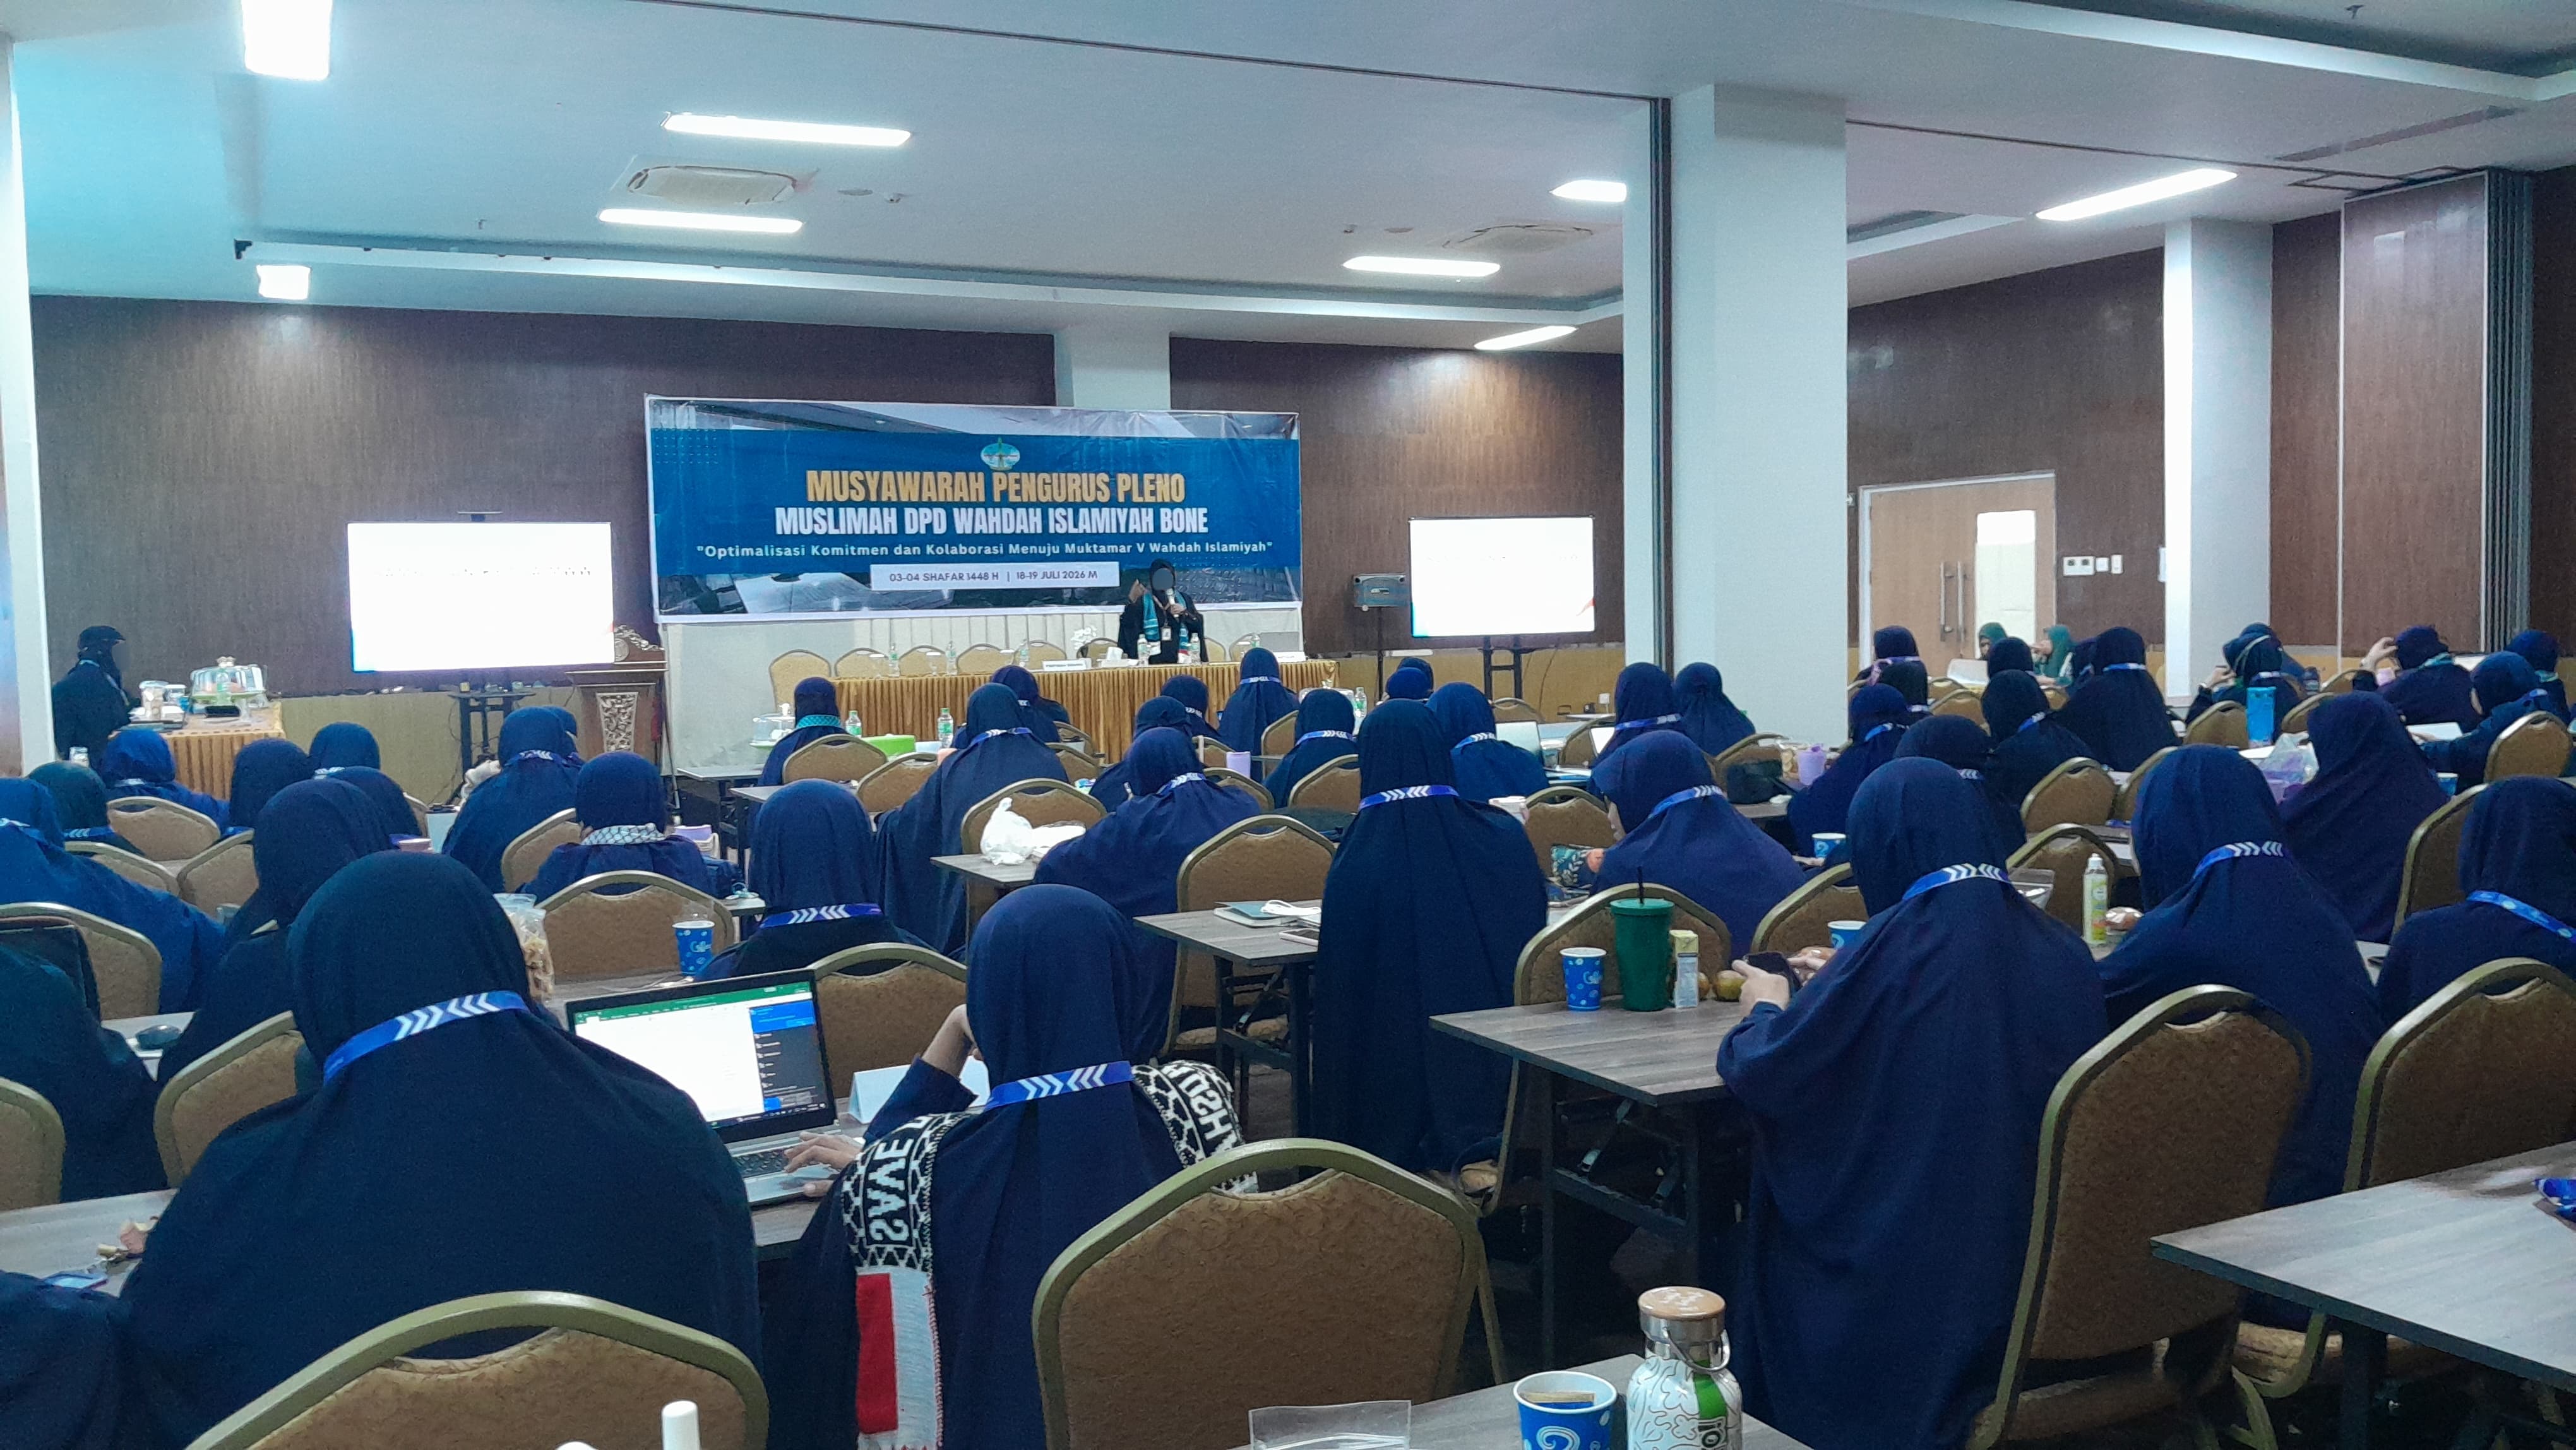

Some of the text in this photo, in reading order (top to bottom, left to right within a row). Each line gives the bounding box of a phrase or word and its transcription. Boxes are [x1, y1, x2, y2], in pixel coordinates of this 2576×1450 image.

[806, 470, 1186, 503] MUSYAWARAH PENGURUS PLENO
[775, 507, 1208, 535] MUSLIMAH DPD WAHDAH ISLAMIYAH BONE
[696, 545, 806, 560] "Optimalisasi
[811, 544, 889, 556] Komitmen
[893, 544, 921, 556] dan
[926, 543, 1004, 556] Kolaborasi
[1008, 543, 1060, 557] Menuju
[1064, 542, 1133, 554] Muktamar
[1136, 542, 1145, 554] V
[1149, 542, 1201, 553] Wahdah
[922, 572, 965, 582] SHAFAR
[967, 572, 989, 580] 1448
[992, 572, 999, 580] H
[1041, 570, 1060, 580] JULI
[1062, 570, 1085, 579] 2026
[1088, 570, 1098, 579] M
